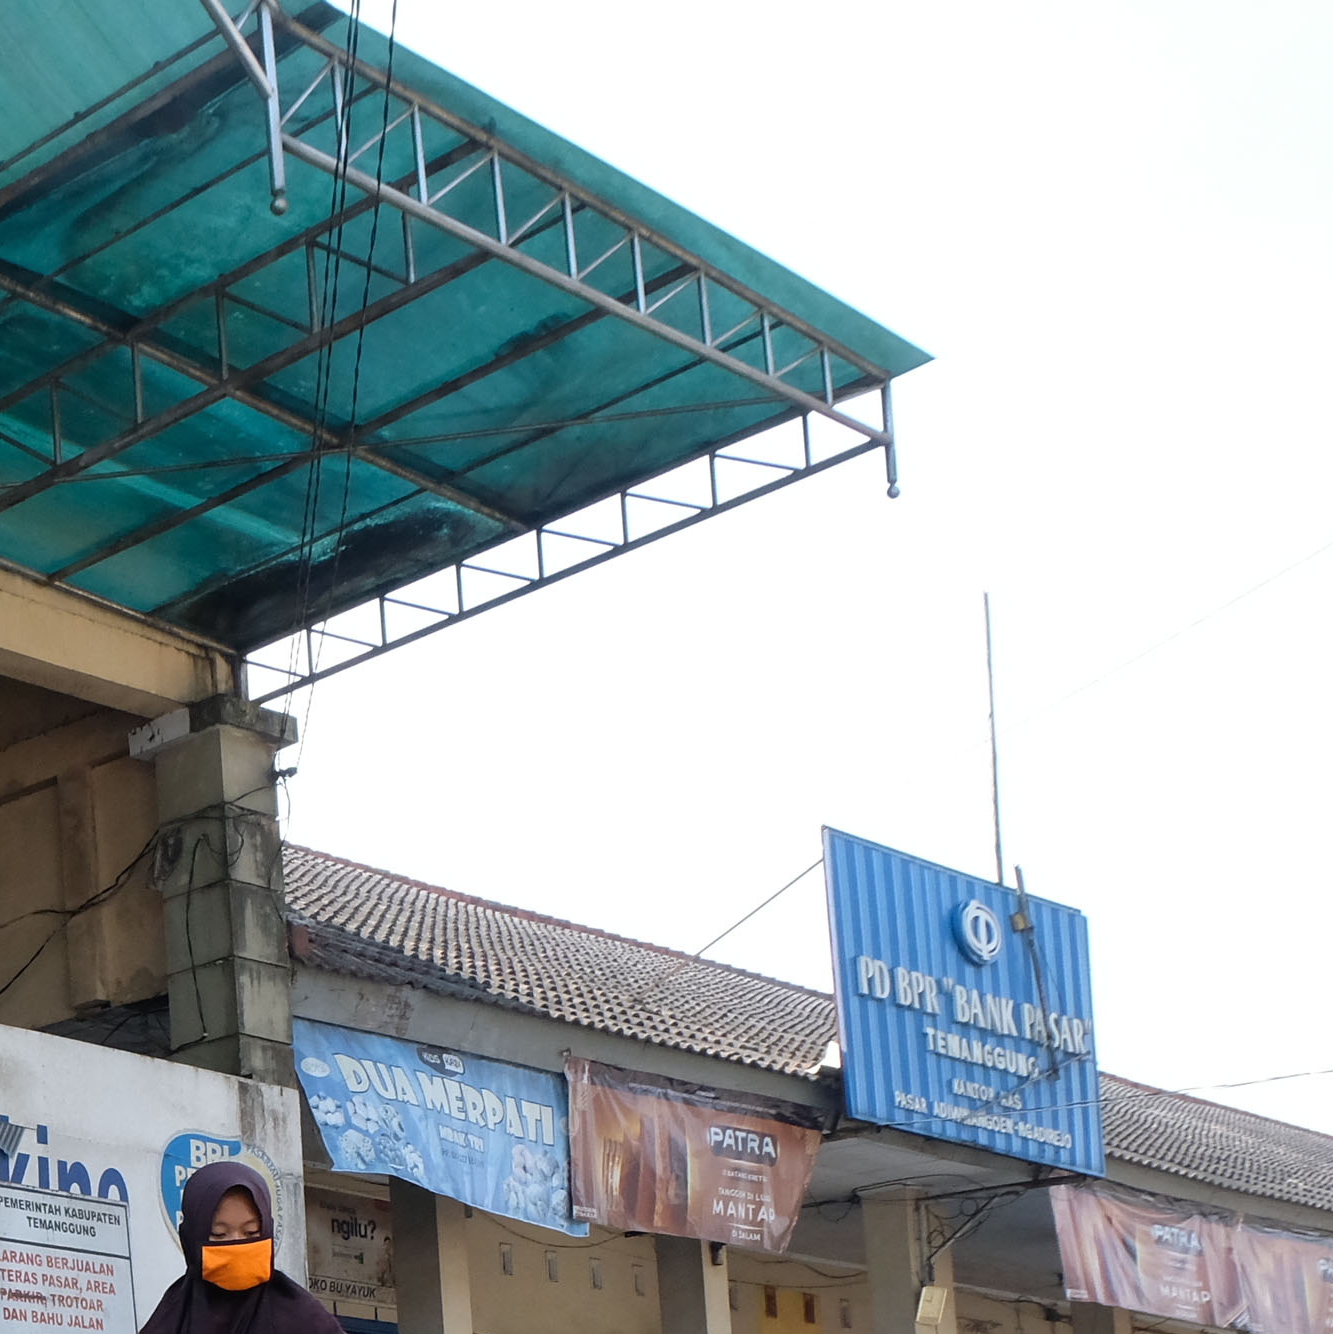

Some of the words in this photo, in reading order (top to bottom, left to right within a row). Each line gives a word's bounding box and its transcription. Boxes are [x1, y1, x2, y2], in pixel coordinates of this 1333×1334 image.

[857, 955, 891, 1000] PD
[894, 967, 940, 1015] BPR
[943, 977, 1018, 1037] "BANK
[925, 1027, 1039, 1078] TEMANGGUNG
[333, 1053, 420, 1107] DUA
[414, 1070, 554, 1146] MERPATI
[895, 1091, 927, 1113] PASAR
[710, 1127, 776, 1158] PATRA
[63, 1204, 121, 1226] KABUPATEN
[713, 1199, 775, 1223] MANTAP
[26, 1216, 96, 1237] TEMANGGUNG
[331, 1217, 376, 1240] ngilu?
[46, 1255, 114, 1277] BERJUALAN
[0, 1268, 38, 1285] TERAS
[42, 1273, 83, 1293] PASAR,
[86, 1280, 116, 1295] AREA
[309, 1278, 327, 1291] OKO
[329, 1280, 343, 1293] BU
[344, 1285, 376, 1298] YAYUK
[49, 1293, 104, 1312] TROTOAR
[3, 1307, 28, 1322] DAN
[31, 1310, 63, 1326] BAHU
[67, 1314, 104, 1331] JALAN
